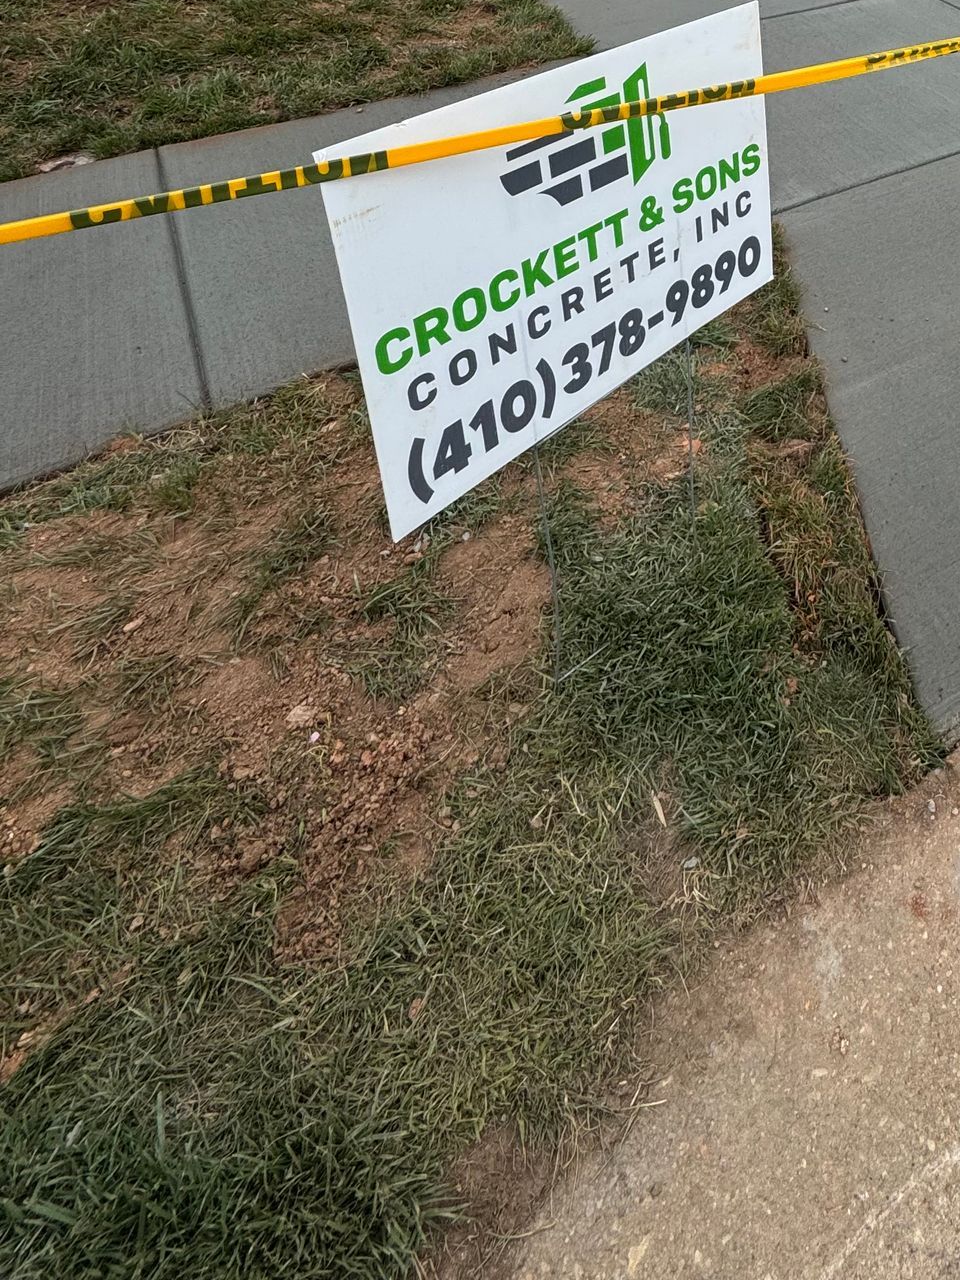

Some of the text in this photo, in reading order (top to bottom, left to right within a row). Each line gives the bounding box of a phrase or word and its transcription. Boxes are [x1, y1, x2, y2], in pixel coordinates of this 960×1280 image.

[375, 144, 760, 374] CROCKETT & SONS
[408, 191, 751, 410] CONCRETE, INC
[409, 236, 760, 504] (410)378-9890
